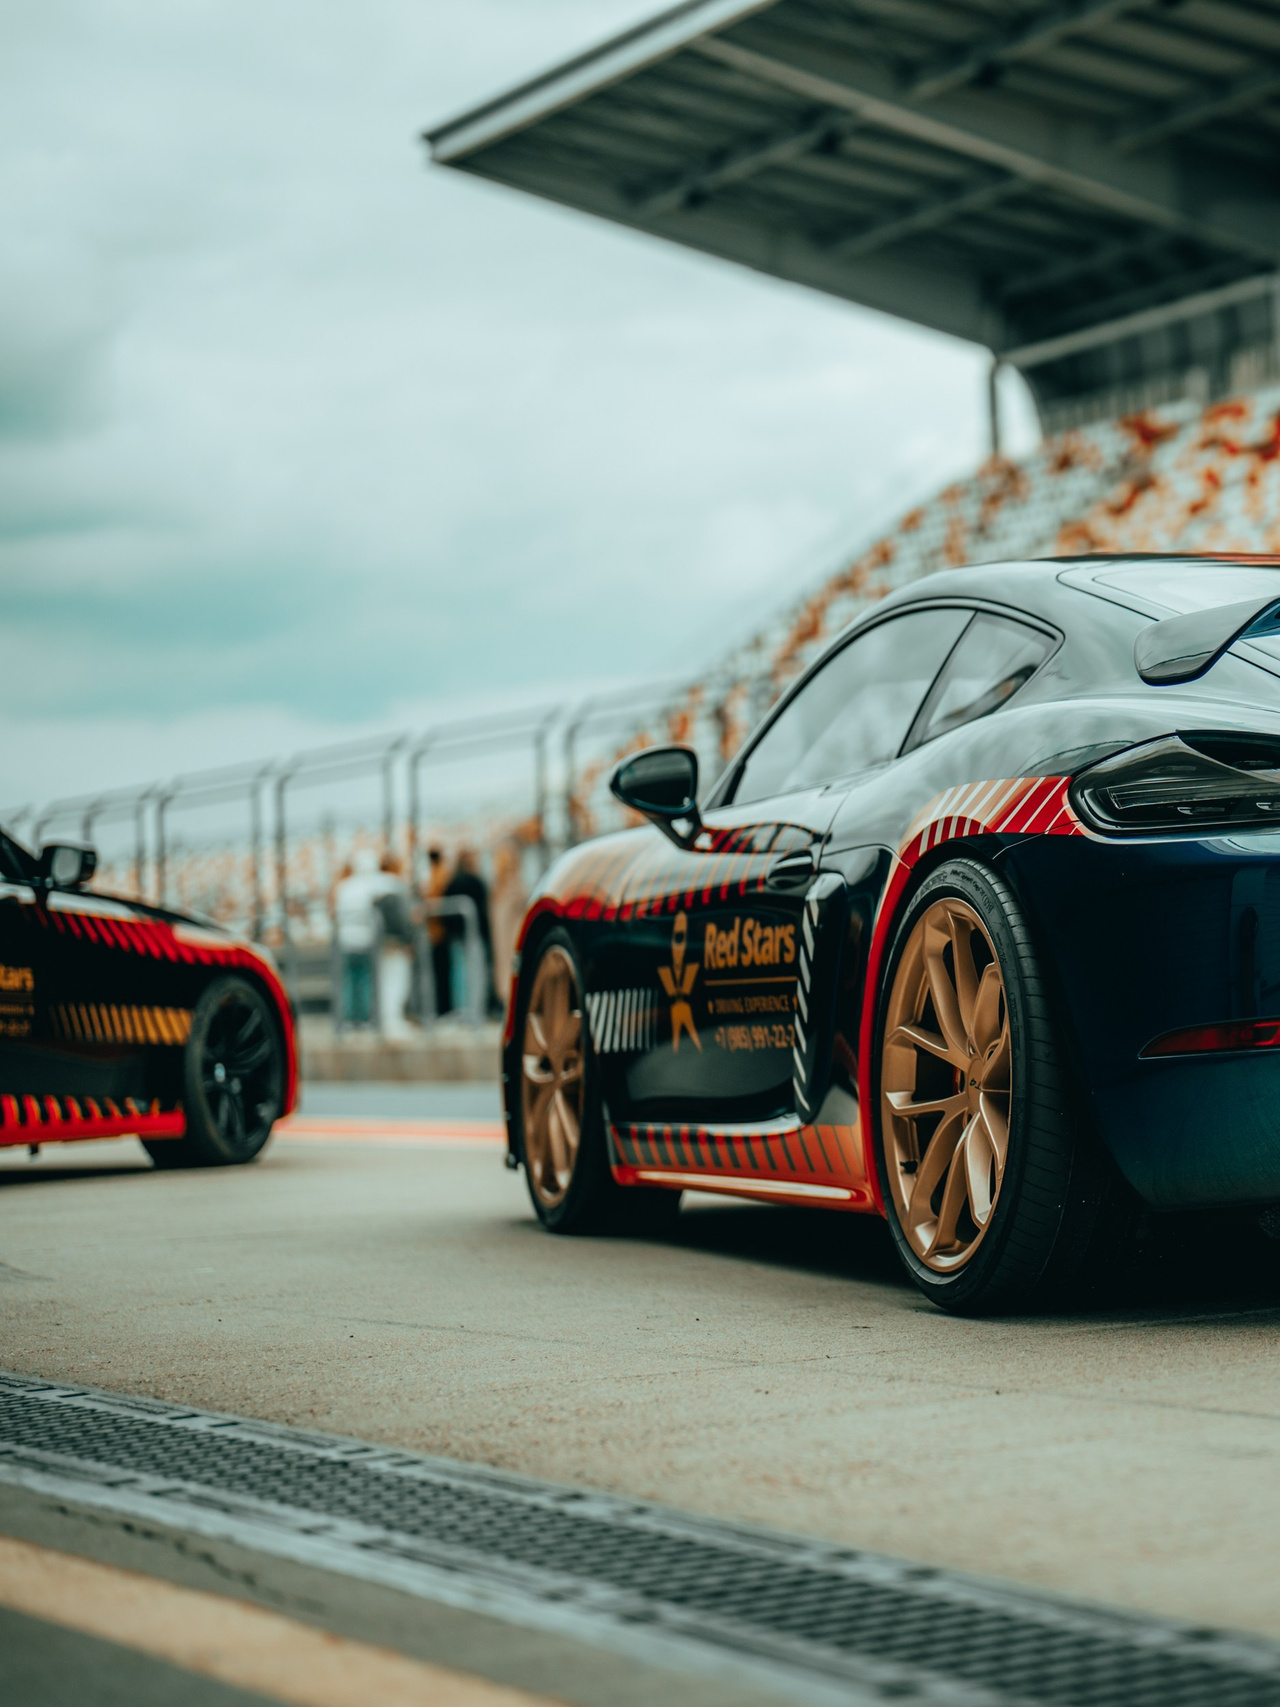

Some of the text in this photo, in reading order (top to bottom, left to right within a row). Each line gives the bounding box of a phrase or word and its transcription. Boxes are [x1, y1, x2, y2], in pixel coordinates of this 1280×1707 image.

[704, 916, 796, 969] Red Stars
[0, 963, 34, 991] tars
[751, 1023, 796, 1049] 991-22-2
